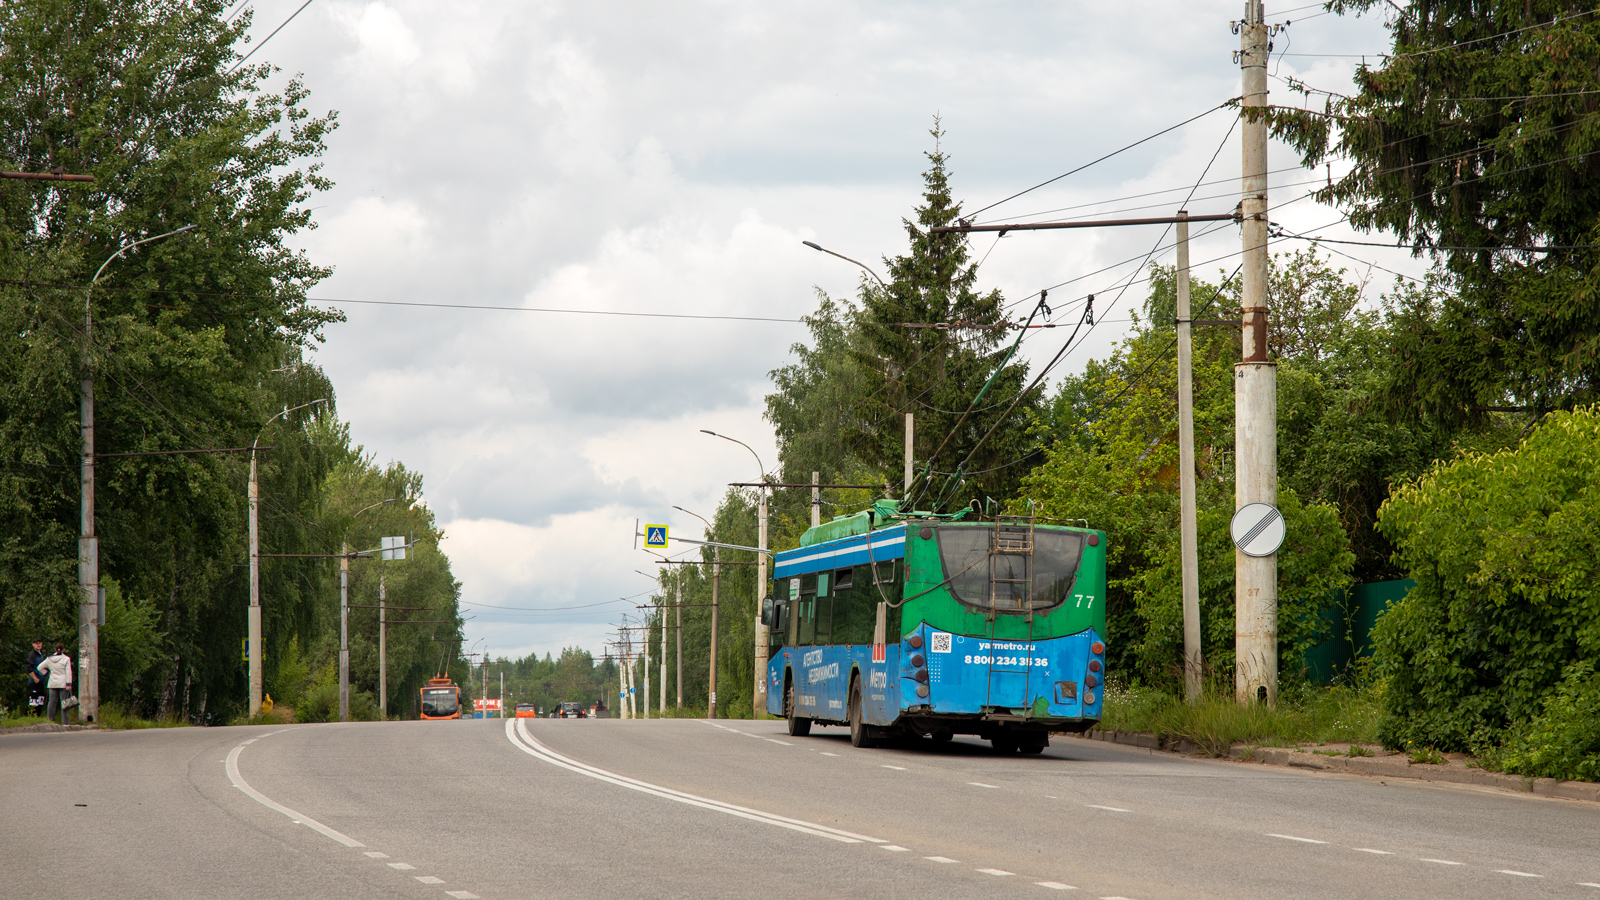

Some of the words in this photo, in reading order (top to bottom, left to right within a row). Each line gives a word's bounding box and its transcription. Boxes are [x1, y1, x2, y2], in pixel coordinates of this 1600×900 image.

[1248, 588, 1260, 597] 27
[1075, 594, 1094, 608] 77
[964, 655, 972, 664] 8
[973, 655, 994, 664] 800
[996, 656, 1017, 665] 234
[1019, 657, 1033, 666] 35
[1034, 658, 1048, 667] 36
[870, 668, 886, 692] Метро
